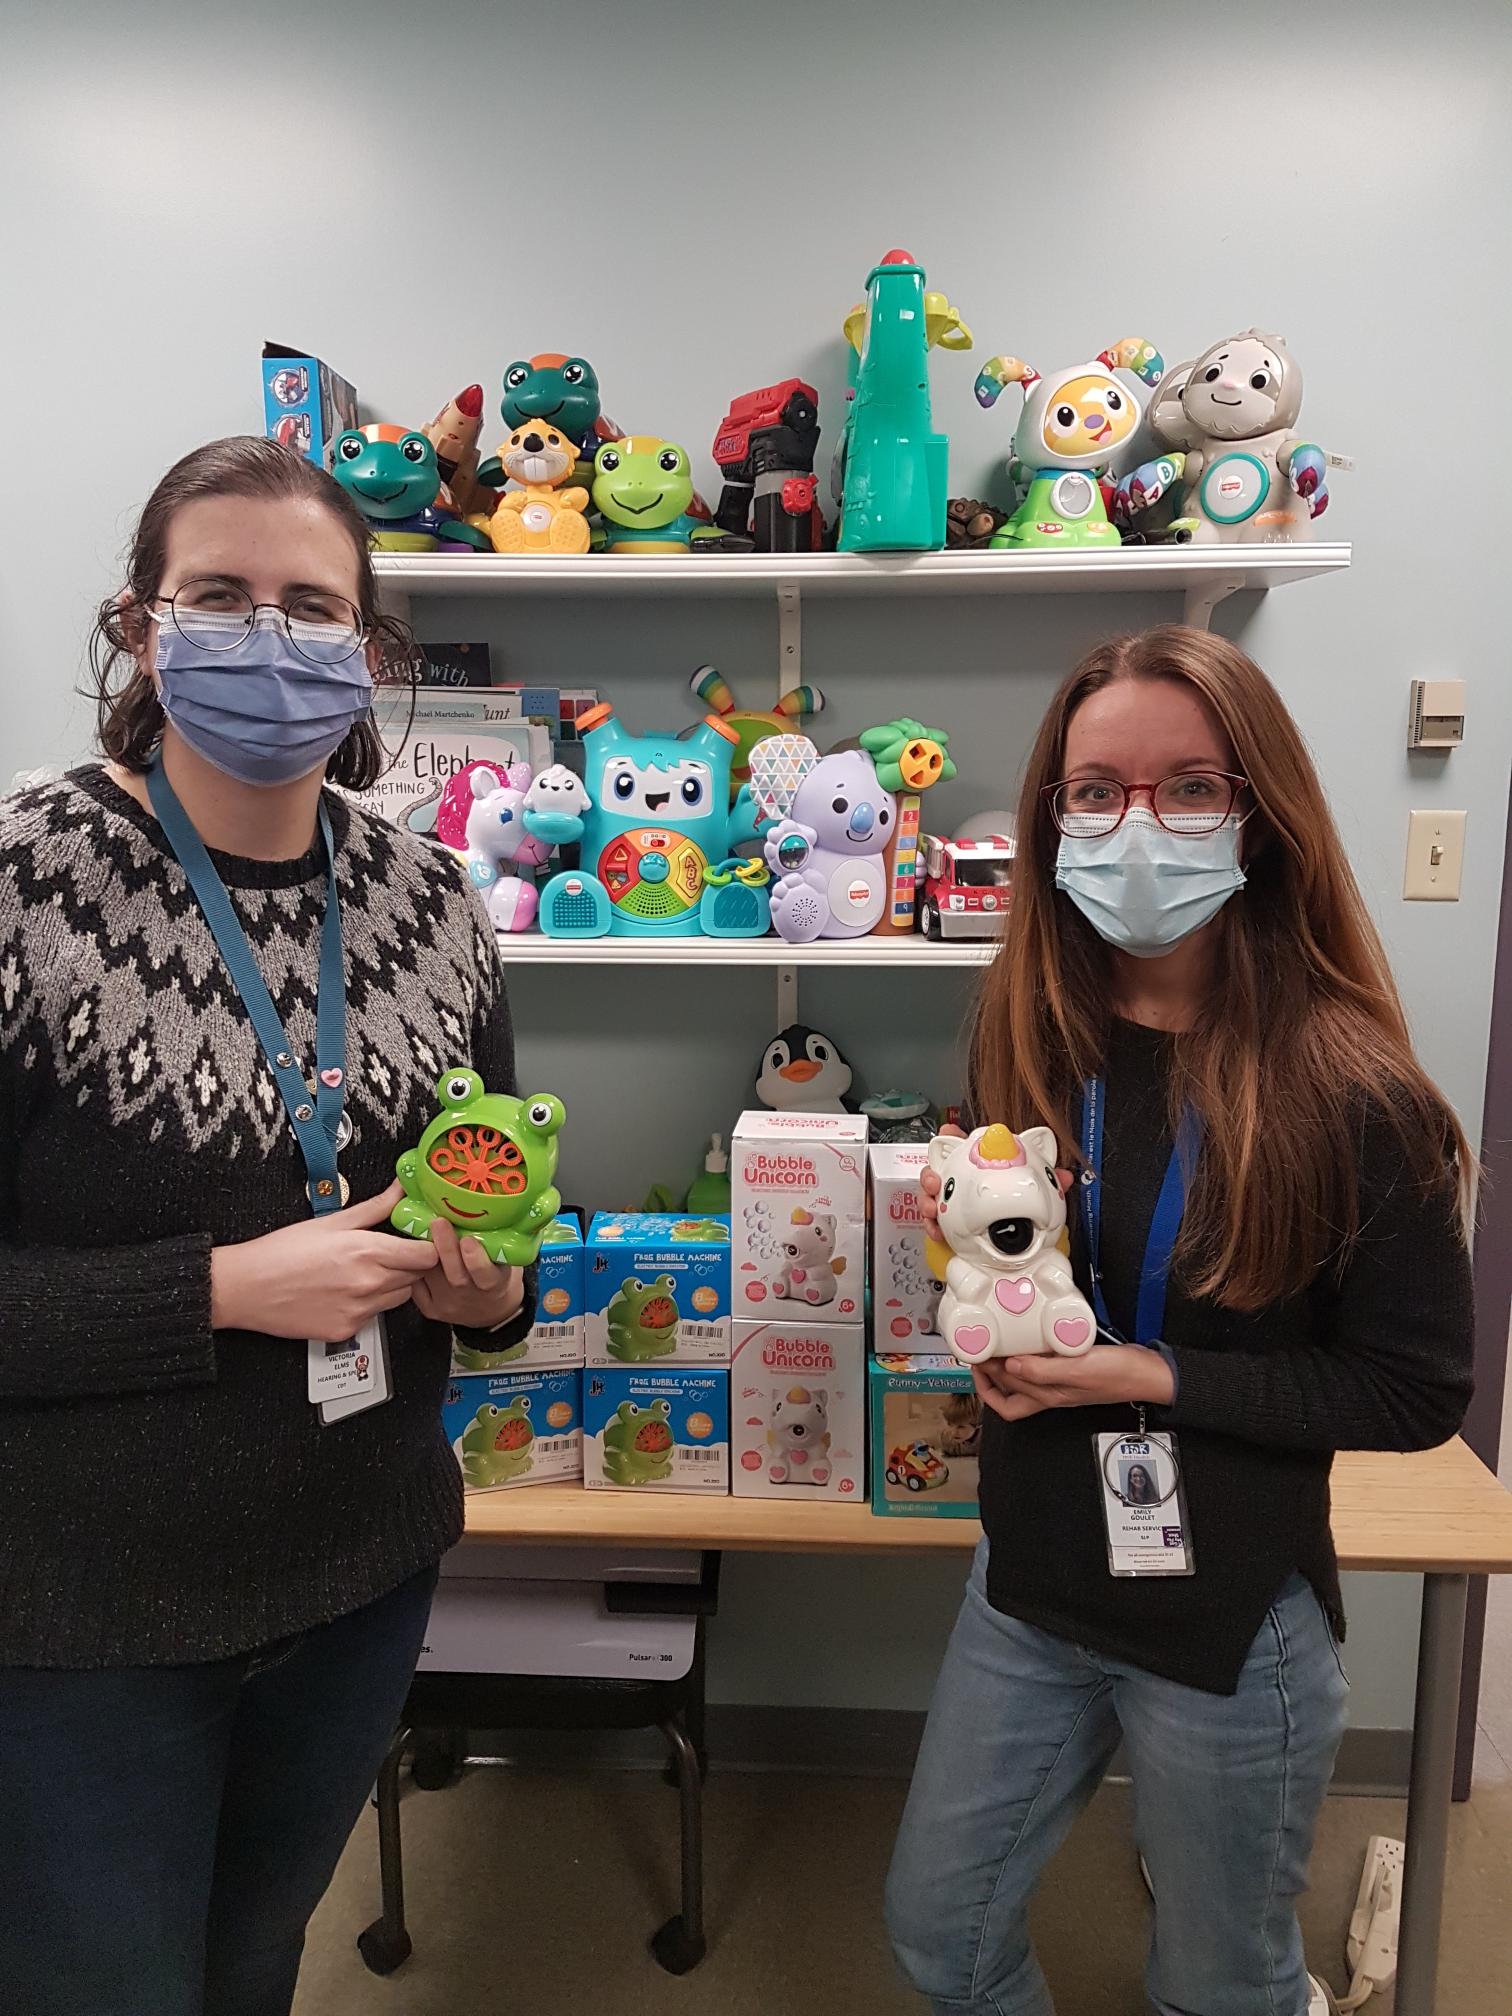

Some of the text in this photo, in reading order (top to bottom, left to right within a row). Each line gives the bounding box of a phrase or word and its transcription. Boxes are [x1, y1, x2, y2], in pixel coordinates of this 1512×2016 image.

[1160, 465, 1171, 481] B
[1147, 486, 1160, 500] A
[430, 663, 469, 687] with
[406, 709, 475, 719] Mchael Martchenko
[413, 741, 517, 779] Elepht
[684, 855, 698, 891] ABC
[757, 1155, 813, 1170] Bubble
[744, 1168, 816, 1185] Unicorn
[656, 1253, 685, 1262] BUBBLE
[687, 1254, 722, 1262] MACHINE
[775, 1338, 830, 1353] Bubble
[329, 1352, 356, 1362] VICTORIA
[762, 1350, 833, 1368] Unicorn
[334, 1362, 350, 1370] ELMS
[317, 1373, 342, 1383] HEARING
[488, 1379, 509, 1388] FROG
[511, 1374, 540, 1385] BUBBLE
[629, 1377, 716, 1388] FROG BUBBLE MACHINE
[629, 1653, 673, 1662] Pulsar 300
